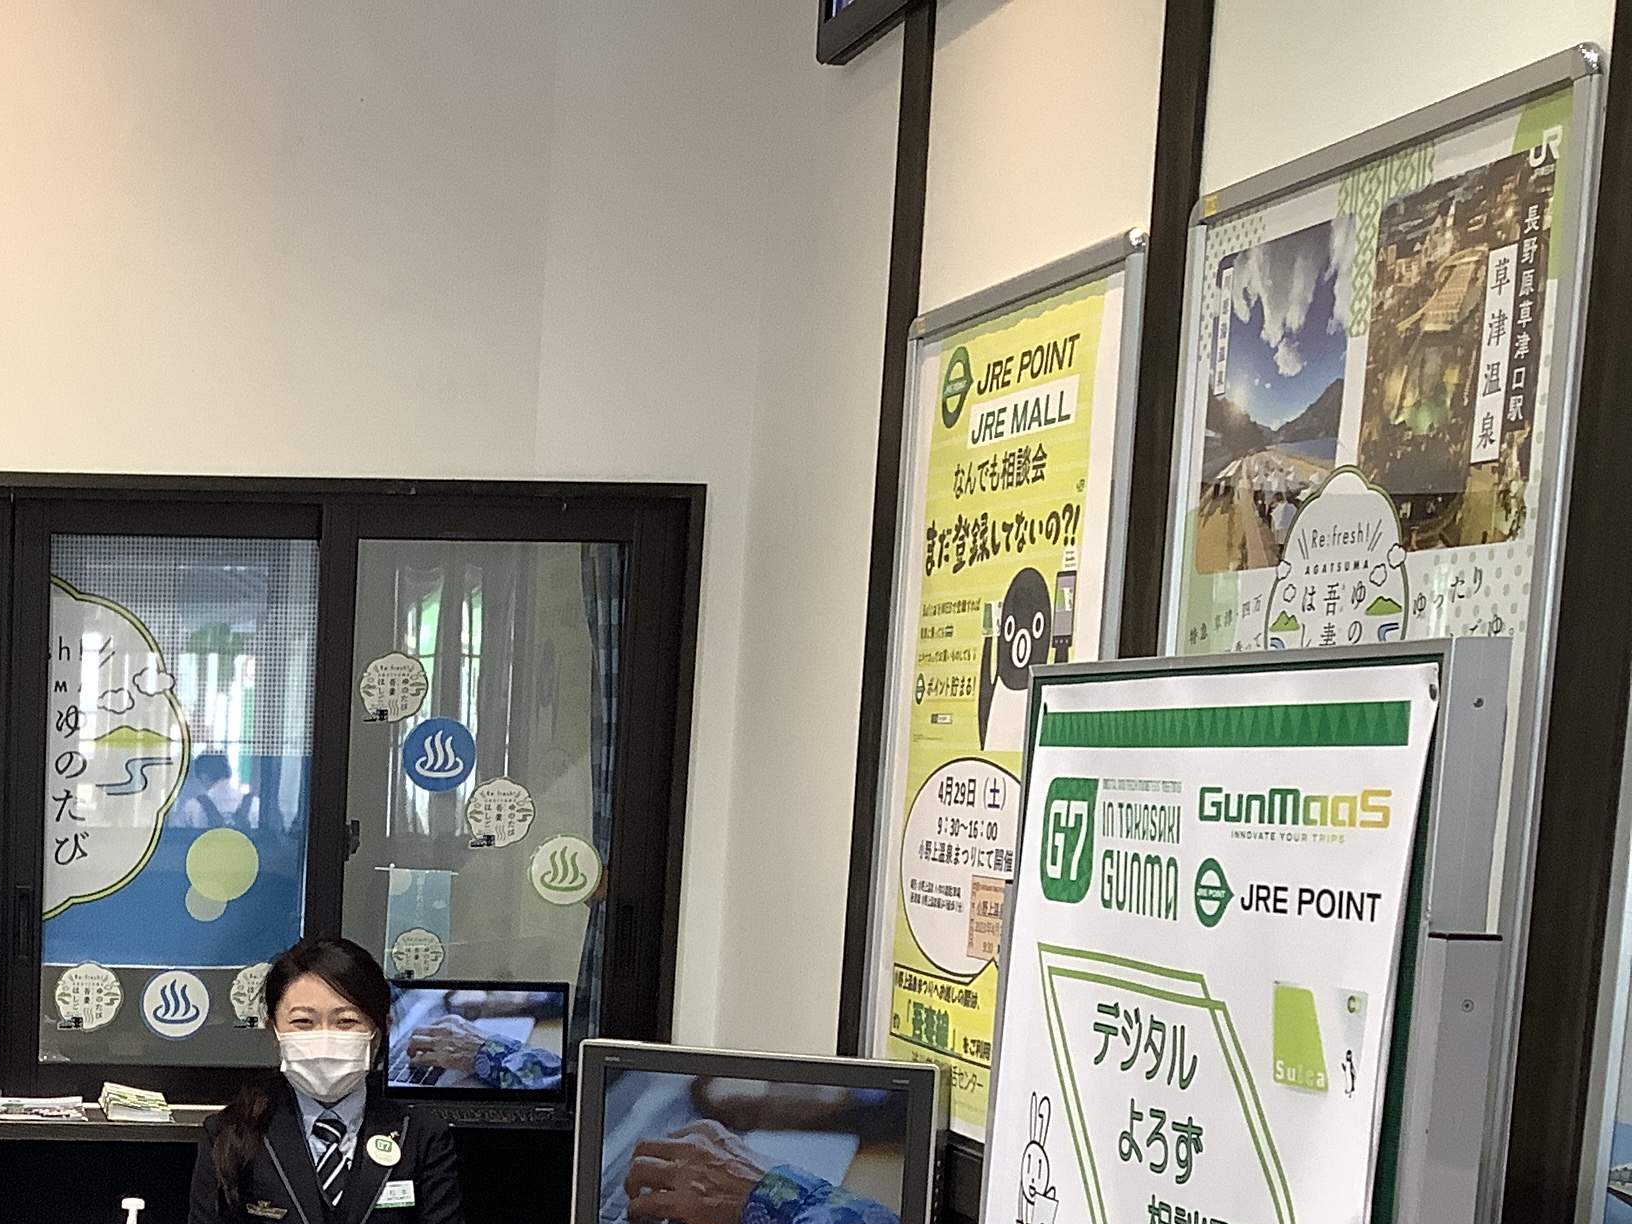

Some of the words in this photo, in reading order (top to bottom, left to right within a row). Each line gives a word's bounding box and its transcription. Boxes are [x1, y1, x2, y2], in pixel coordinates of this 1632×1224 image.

[1506, 204, 1541, 423] 長野原草津口駅
[977, 355, 1014, 395] JRE
[1017, 333, 1081, 384] POINT
[1476, 258, 1511, 449] 草津温泉
[971, 406, 1008, 445] JRE
[1010, 389, 1071, 434] MALL
[953, 442, 1048, 500] なんでも相談会
[1304, 559, 1370, 576] AGATSUMA
[52, 705, 90, 866] ゆのたび
[1046, 800, 1088, 881] G7
[1102, 801, 1114, 837] IN
[1118, 802, 1181, 844] TAKASAKI
[1231, 830, 1276, 841] INNOVATE
[1279, 832, 1308, 843] YOUR
[1312, 833, 1345, 844] TRIPS
[1101, 849, 1178, 921] GUNMA
[1240, 883, 1289, 914] JRE
[1297, 887, 1382, 922] POINT
[1092, 1000, 1198, 1091] デジタル
[1275, 1060, 1325, 1088] Suica
[1118, 1097, 1203, 1184] よろず
